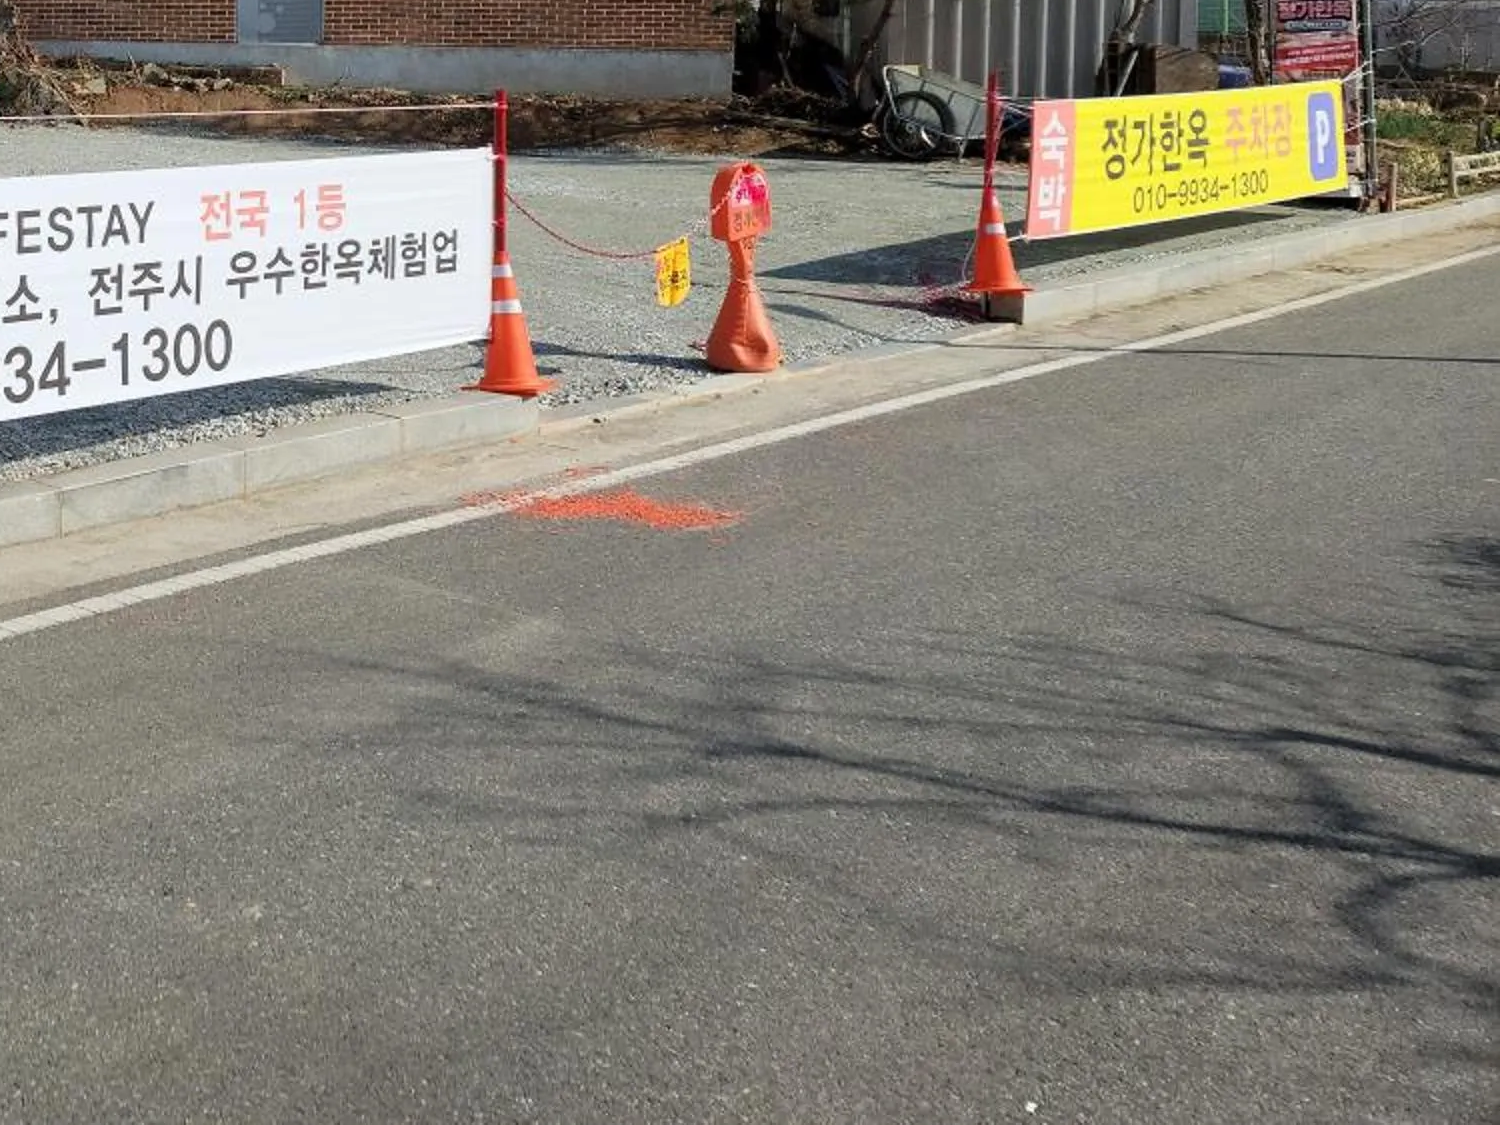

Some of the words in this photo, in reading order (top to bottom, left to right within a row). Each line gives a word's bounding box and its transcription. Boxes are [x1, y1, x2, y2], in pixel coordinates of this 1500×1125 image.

[1038, 109, 1070, 232] 숙박
[1101, 108, 1211, 181] 정가한옥
[1224, 101, 1293, 160] 주차장
[200, 190, 270, 241] 전국
[293, 183, 347, 231] 1등
[1132, 169, 1270, 214] 010-9934-1300
[88, 255, 203, 317] 전주시
[225, 227, 460, 299] 우수한옥체험업
